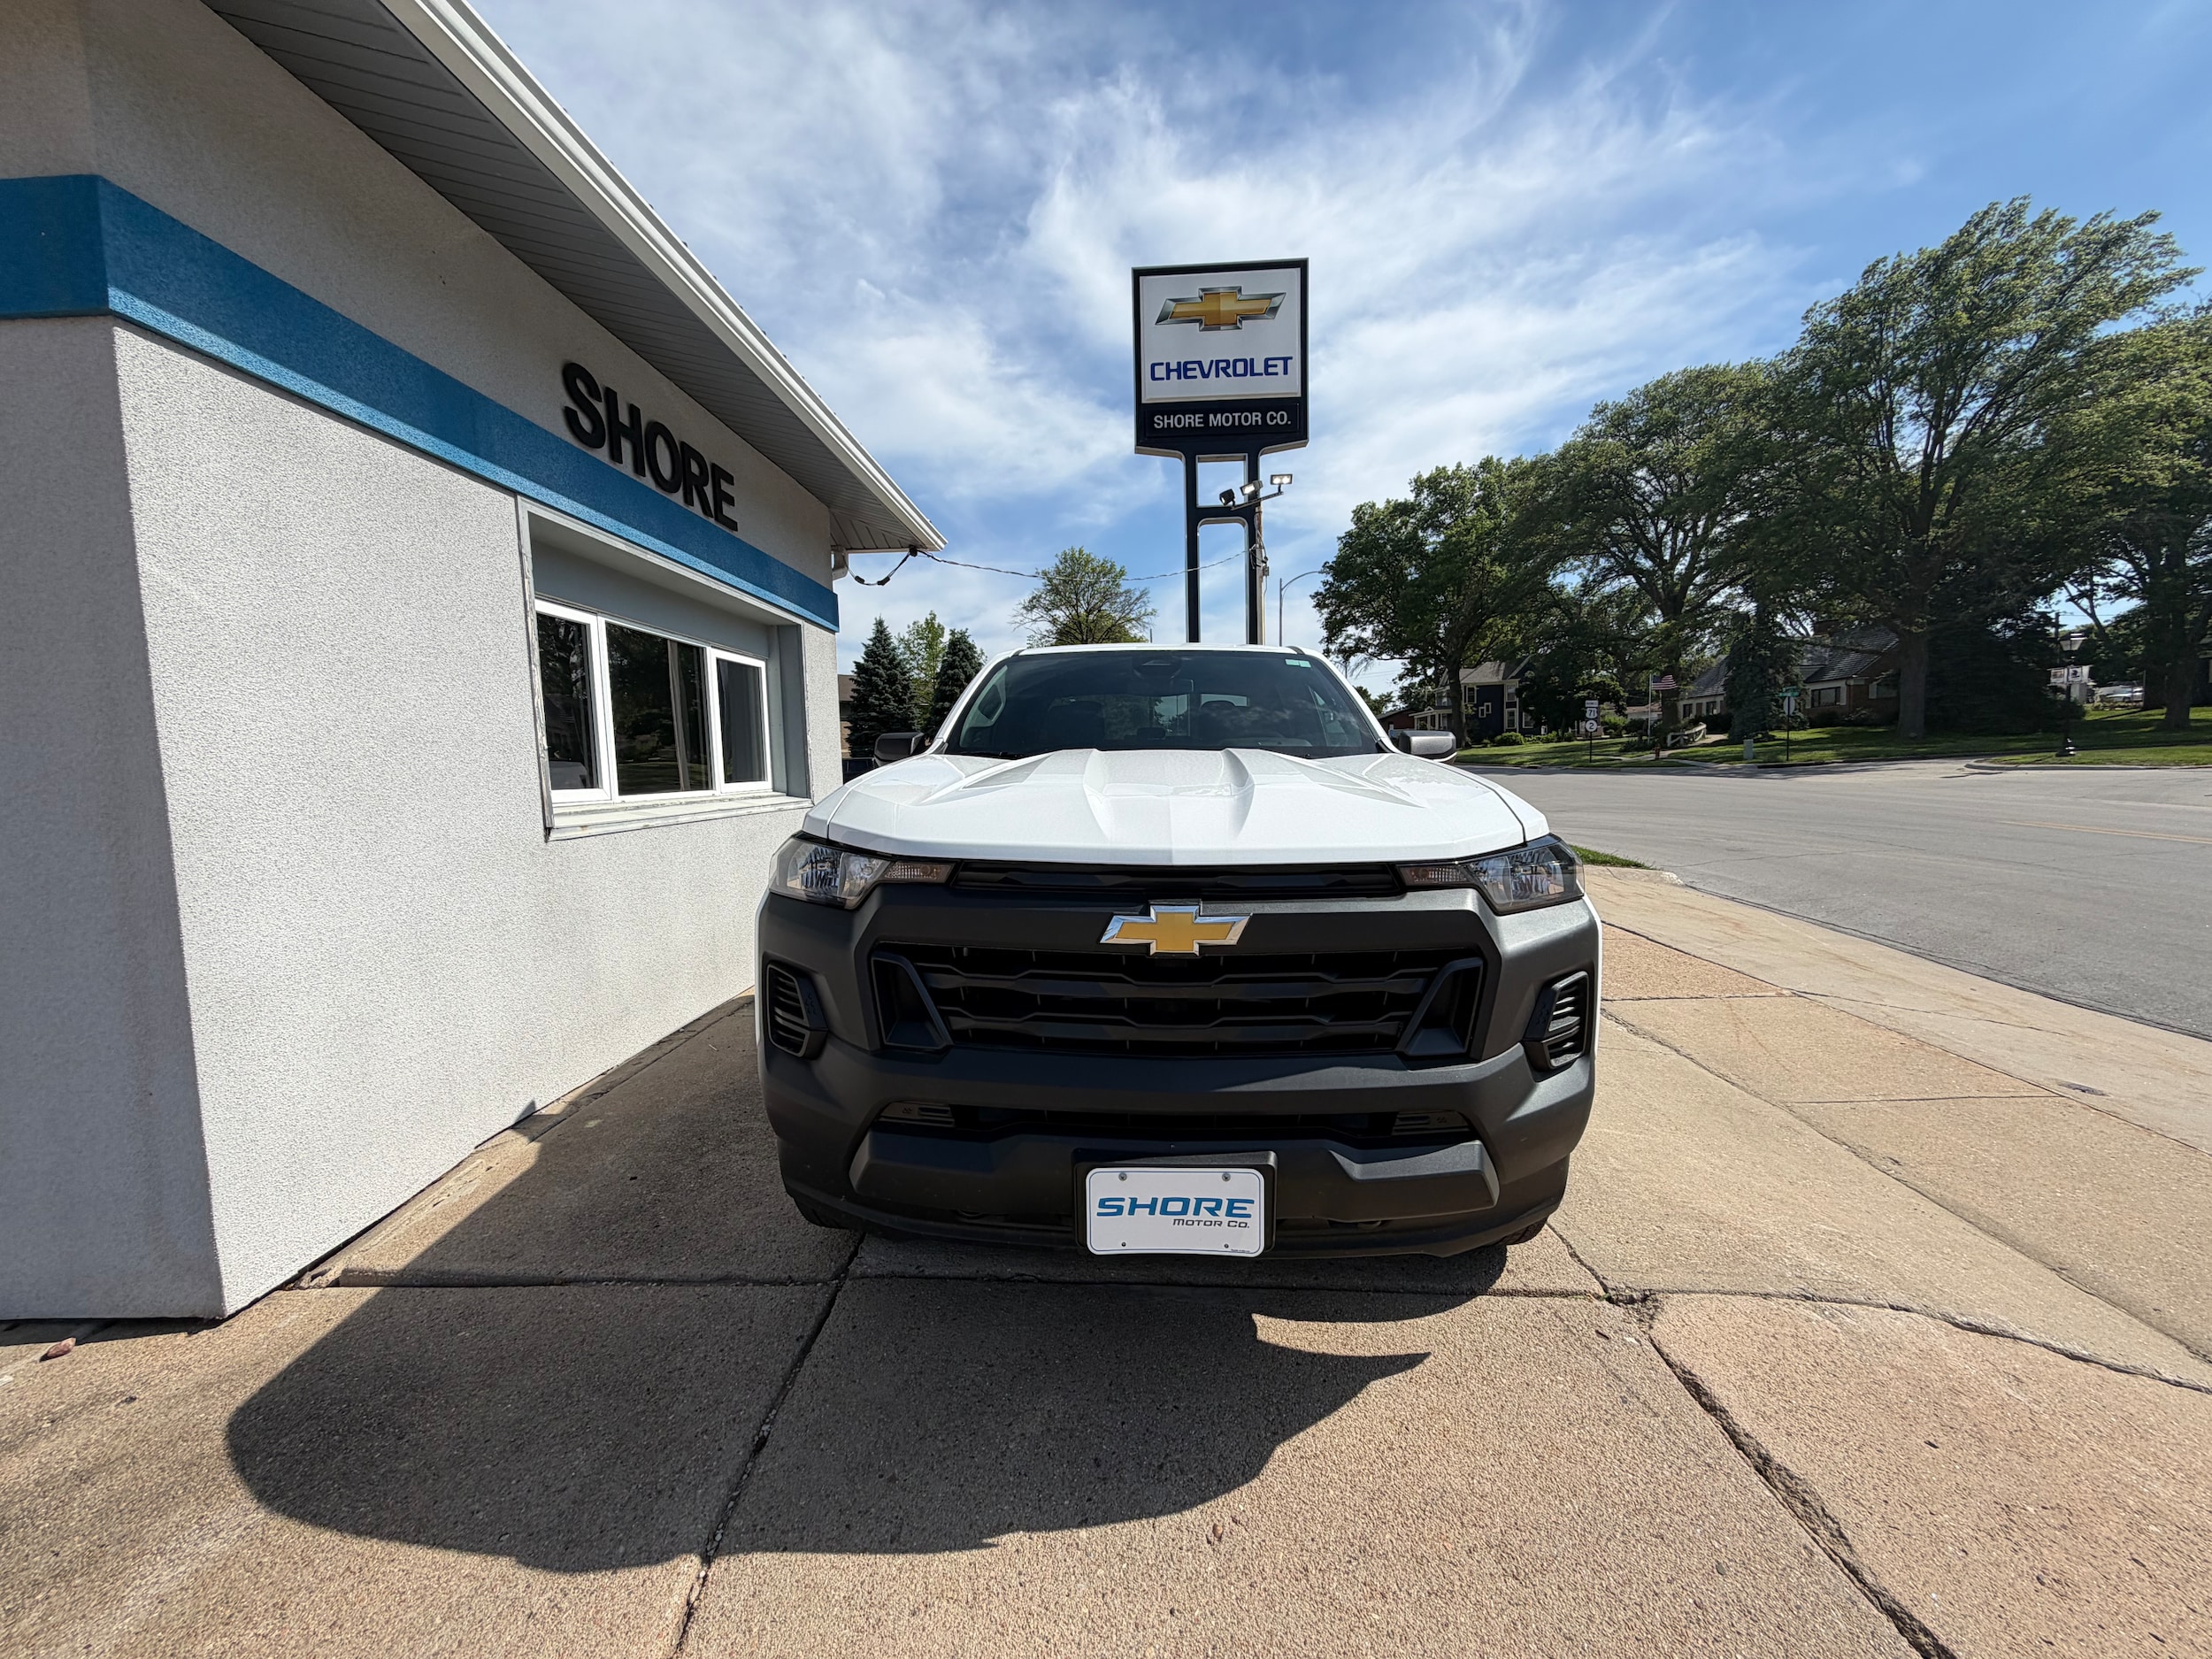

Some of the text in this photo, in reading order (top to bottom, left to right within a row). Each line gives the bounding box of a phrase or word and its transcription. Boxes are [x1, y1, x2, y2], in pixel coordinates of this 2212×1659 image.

[1150, 357, 1293, 380] CHEVROLET
[1153, 411, 1292, 428] SHORE MOTOR CO.
[562, 362, 739, 532] SHORE
[1096, 1197, 1255, 1218] SHORE
[1172, 1218, 1223, 1227] MOTOR
